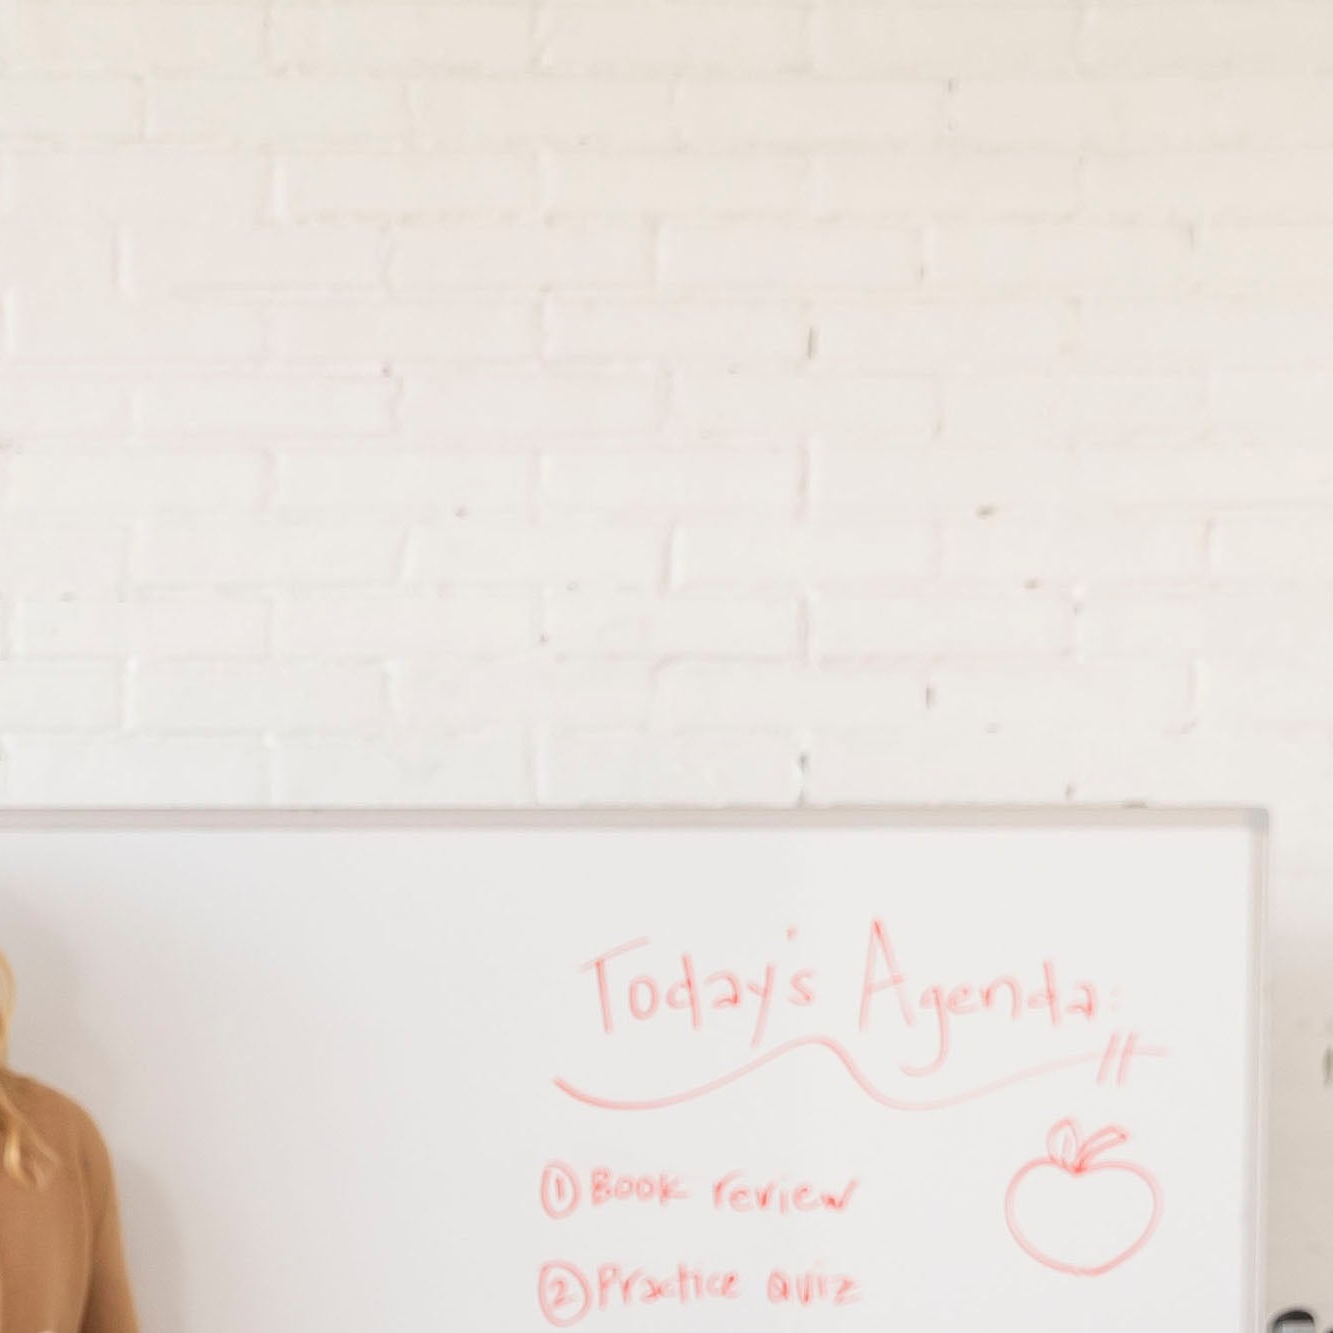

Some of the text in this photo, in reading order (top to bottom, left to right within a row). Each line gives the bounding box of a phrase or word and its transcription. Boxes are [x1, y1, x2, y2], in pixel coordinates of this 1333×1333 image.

[576, 922, 819, 1050] Today's
[590, 1166, 690, 1207] Book
[711, 1168, 861, 1215] review
[596, 1262, 741, 1312] Practice
